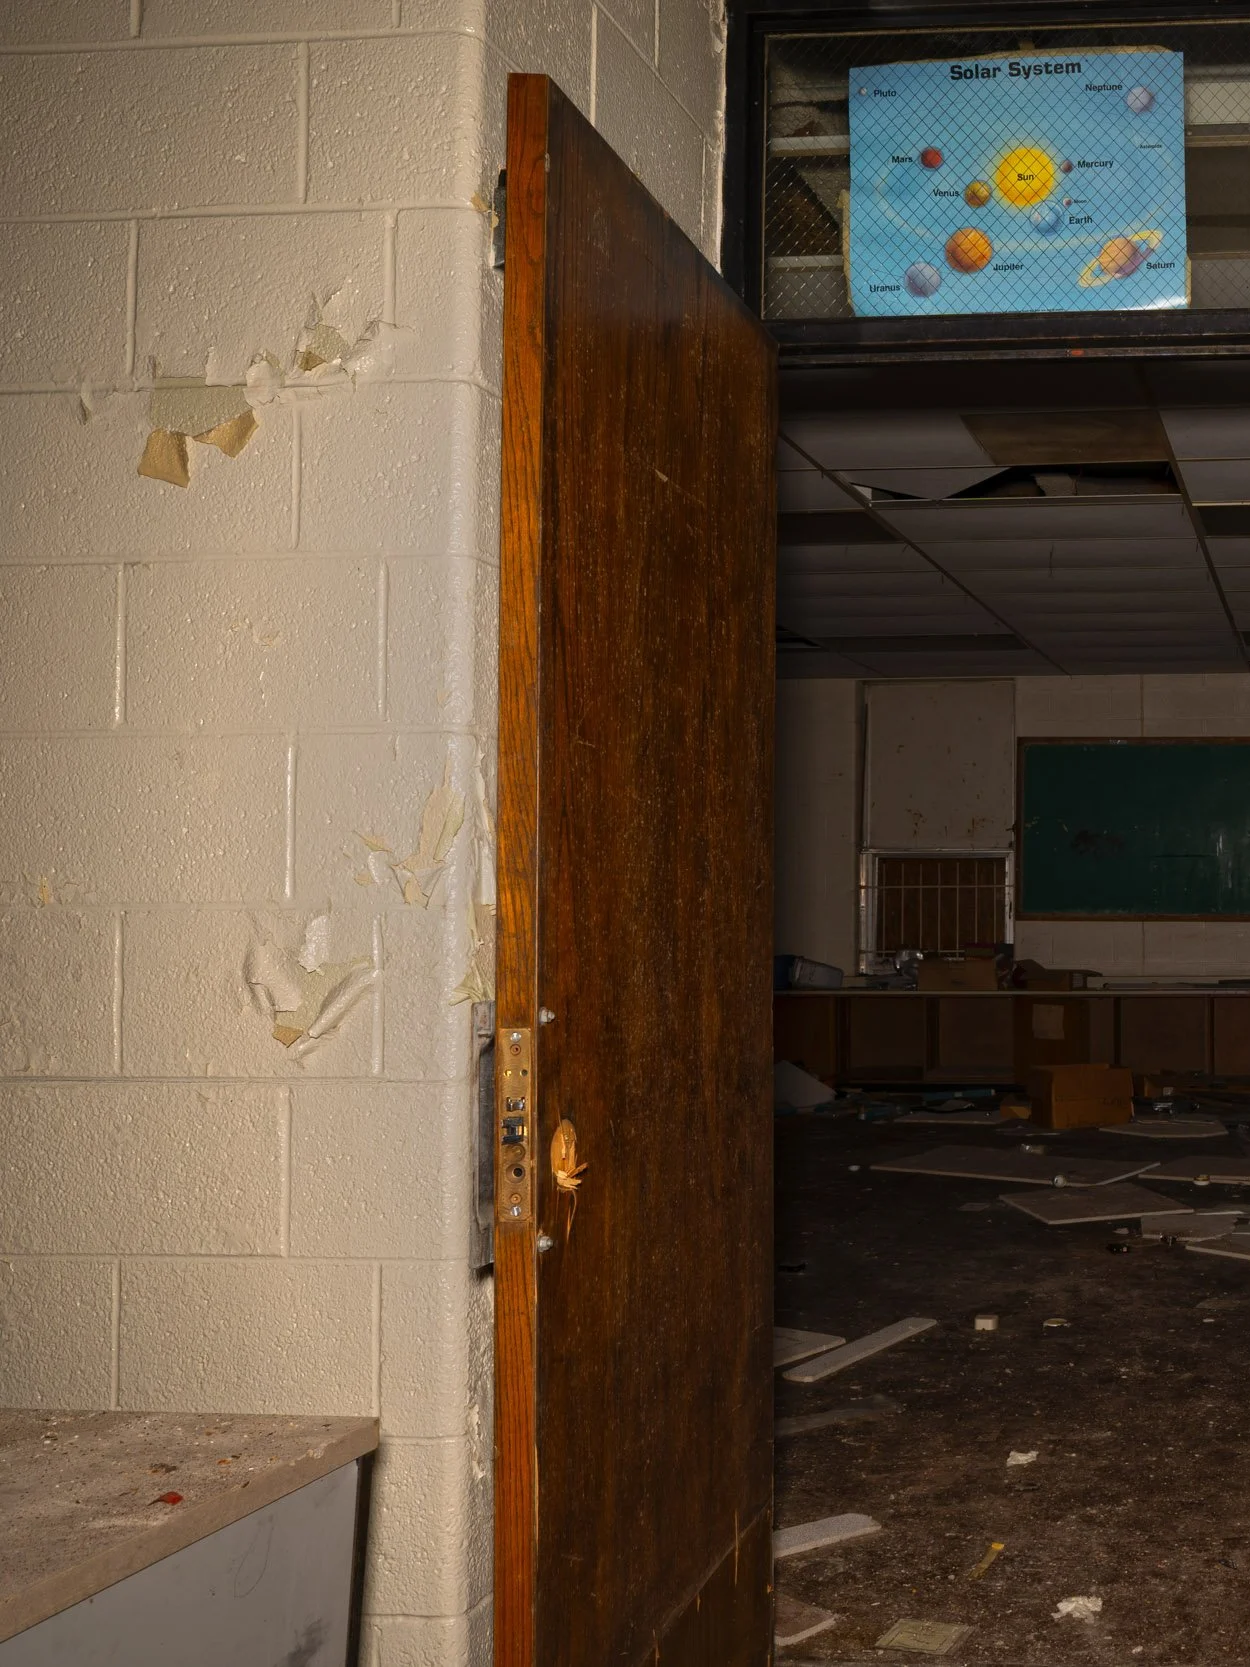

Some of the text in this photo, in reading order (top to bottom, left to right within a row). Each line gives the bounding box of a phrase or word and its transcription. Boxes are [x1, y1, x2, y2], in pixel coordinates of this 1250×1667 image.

[950, 62, 1082, 81] Solar System
[1085, 83, 1123, 93] Neptune
[873, 89, 897, 98] Pluto
[892, 155, 913, 164] Mars
[1077, 159, 1114, 170] Mercury
[1017, 173, 1034, 181] Sun
[933, 189, 960, 198] Venus
[1069, 215, 1093, 225] Earth
[993, 262, 1024, 273] Jupiter
[1146, 261, 1175, 270] Saturn
[869, 284, 900, 293] Uranus
